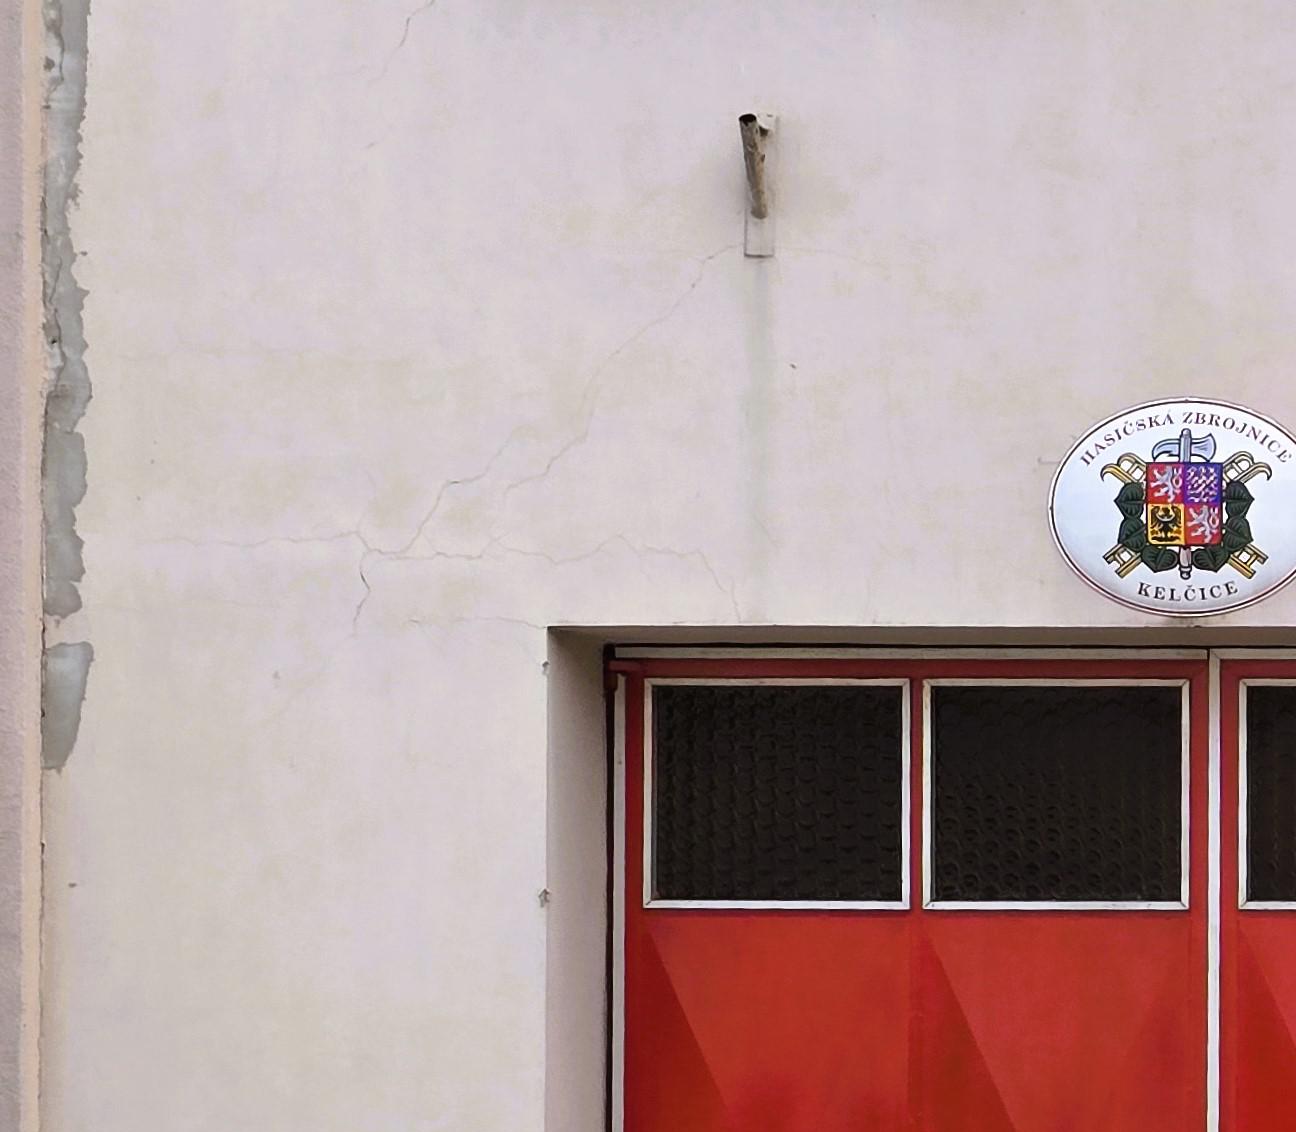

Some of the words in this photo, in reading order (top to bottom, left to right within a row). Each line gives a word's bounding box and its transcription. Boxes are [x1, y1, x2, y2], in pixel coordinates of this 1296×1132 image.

[1080, 410, 1175, 467] HASIČSKÁ
[1182, 411, 1293, 463] ZBROJNICE
[1137, 581, 1239, 601] KELČICE
